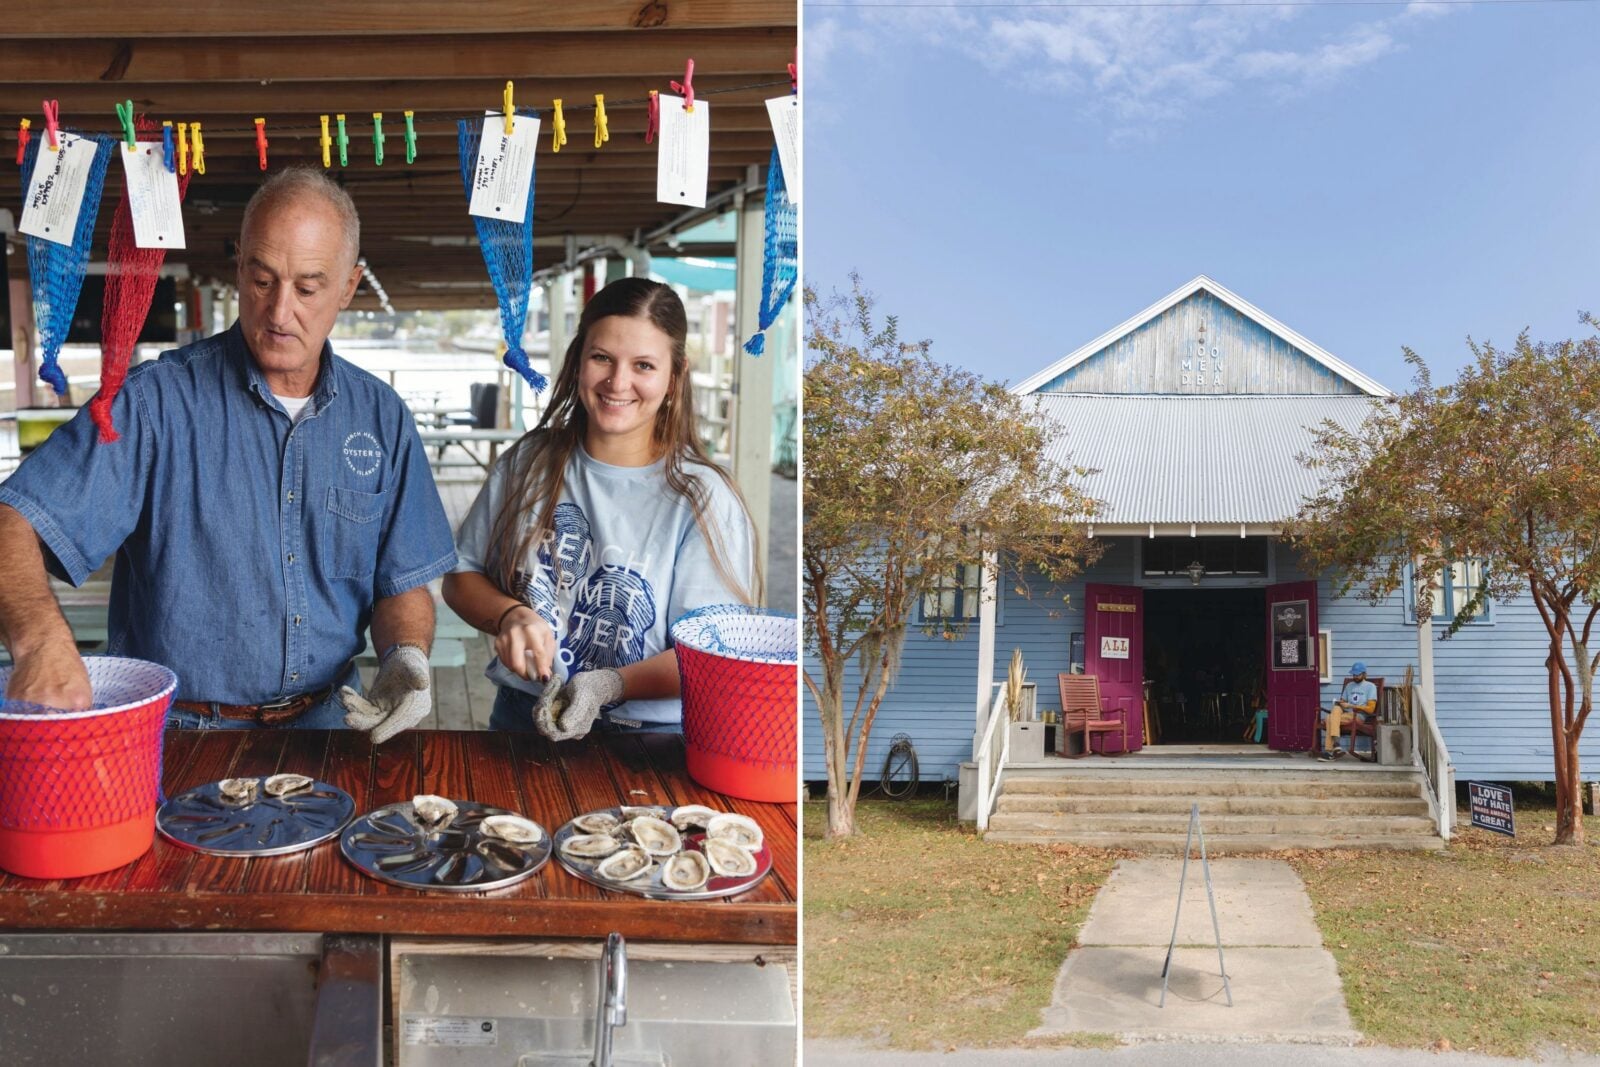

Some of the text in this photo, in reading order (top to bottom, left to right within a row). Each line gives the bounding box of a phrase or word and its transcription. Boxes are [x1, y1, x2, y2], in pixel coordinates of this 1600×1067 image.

[1181, 360, 1223, 372] MEN
[343, 448, 373, 457] OYSTER
[538, 528, 652, 580] RENCH
[519, 562, 644, 616] ERMIT
[1102, 639, 1127, 652] ALL
[1477, 787, 1504, 801] LOVE
[1472, 795, 1511, 813] NOT HATE
[1480, 814, 1506, 828] GREAT
